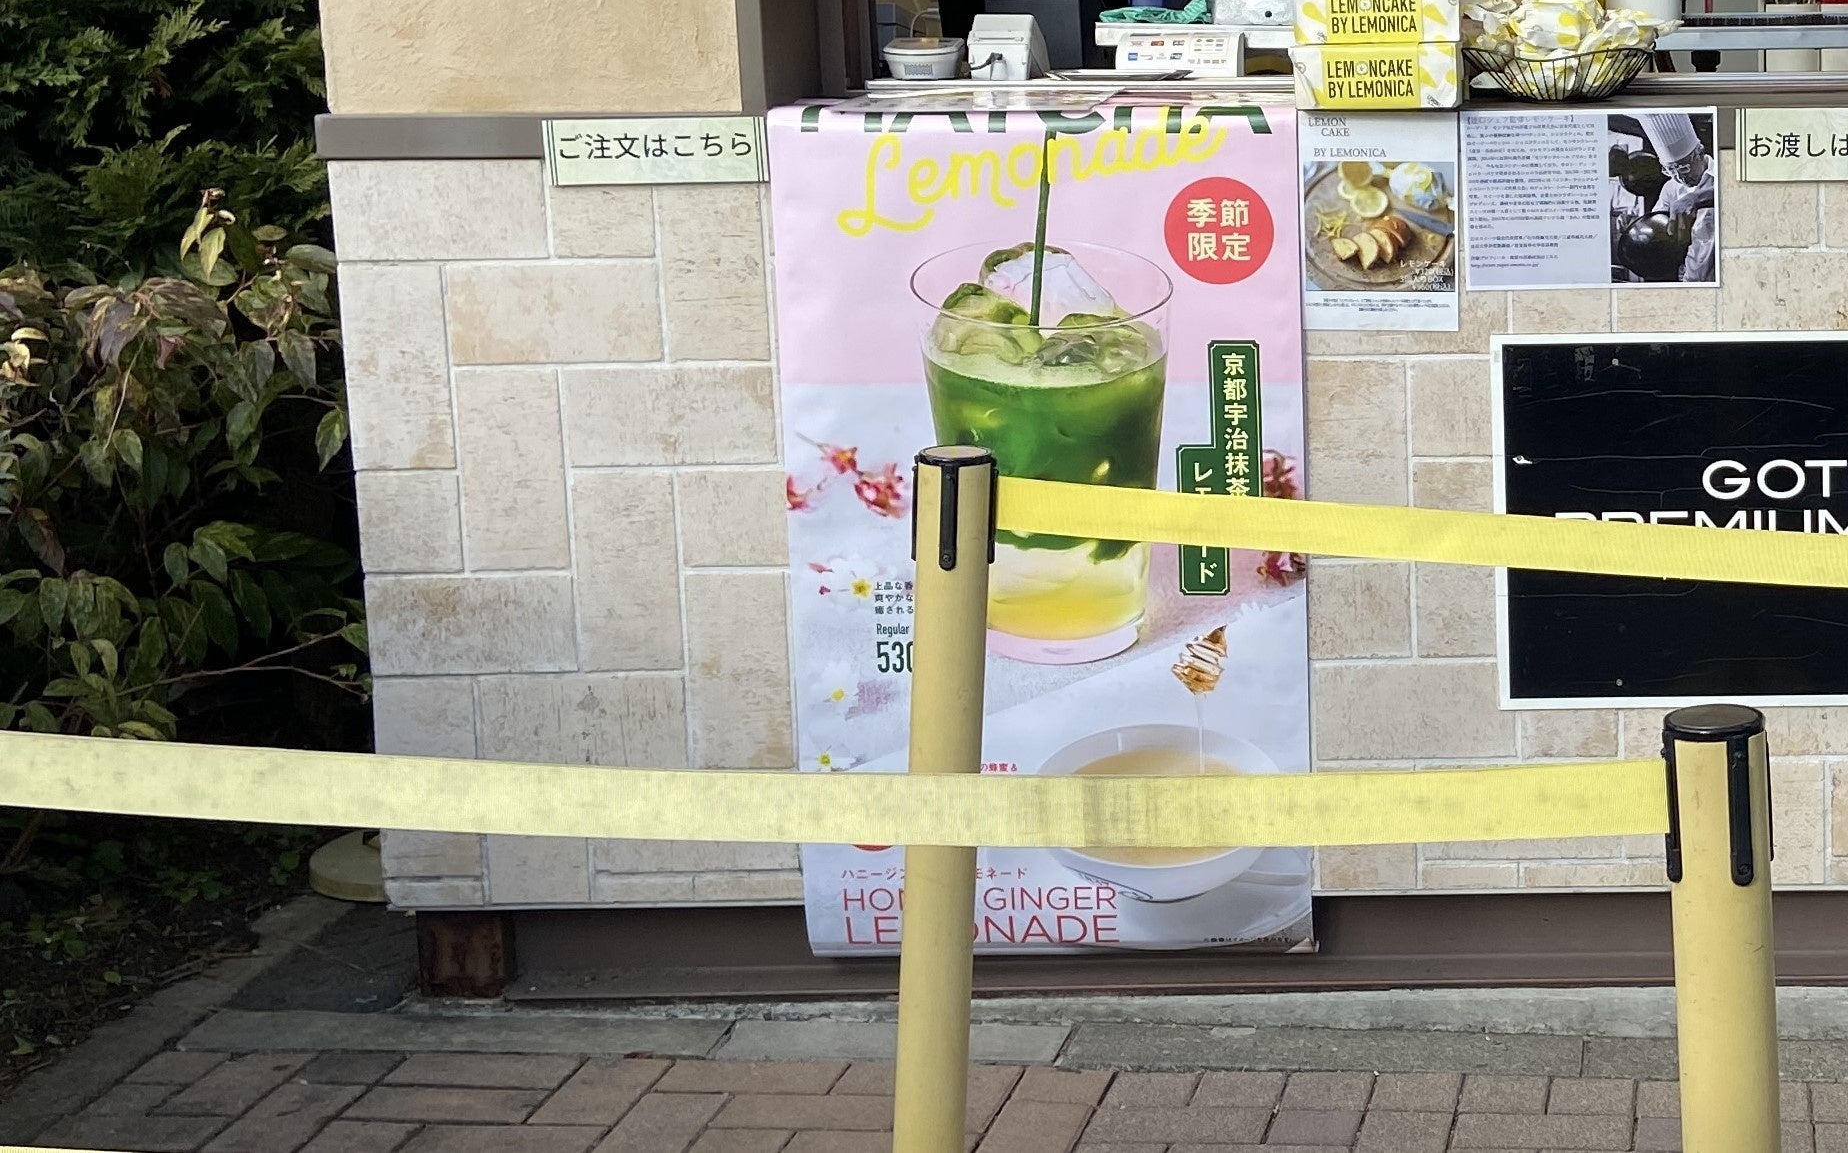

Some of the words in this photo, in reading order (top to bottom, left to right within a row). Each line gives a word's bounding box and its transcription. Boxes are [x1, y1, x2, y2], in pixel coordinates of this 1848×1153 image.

[1331, 16, 1348, 34] BY
[1351, 15, 1418, 34] LEMONICA
[1327, 59, 1414, 78] LEMONCAKE
[1328, 81, 1344, 99] BY
[1348, 80, 1414, 99] LEMONICA
[1308, 117, 1347, 127] LEMON
[1321, 127, 1350, 137] CAKE
[558, 132, 754, 160] ご注文はこちら
[1313, 148, 1327, 158] BY
[1330, 148, 1387, 158] LEMONICA
[836, 105, 1228, 238] Lemonade
[1187, 197, 1251, 227] 季節
[1187, 231, 1252, 261] 限定
[1221, 352, 1251, 498] 京都宇治抹茶
[874, 593, 913, 603] 爽やかな
[874, 605, 914, 615] 癒される
[876, 623, 910, 638] Regular
[988, 886, 1117, 911] GINGER
